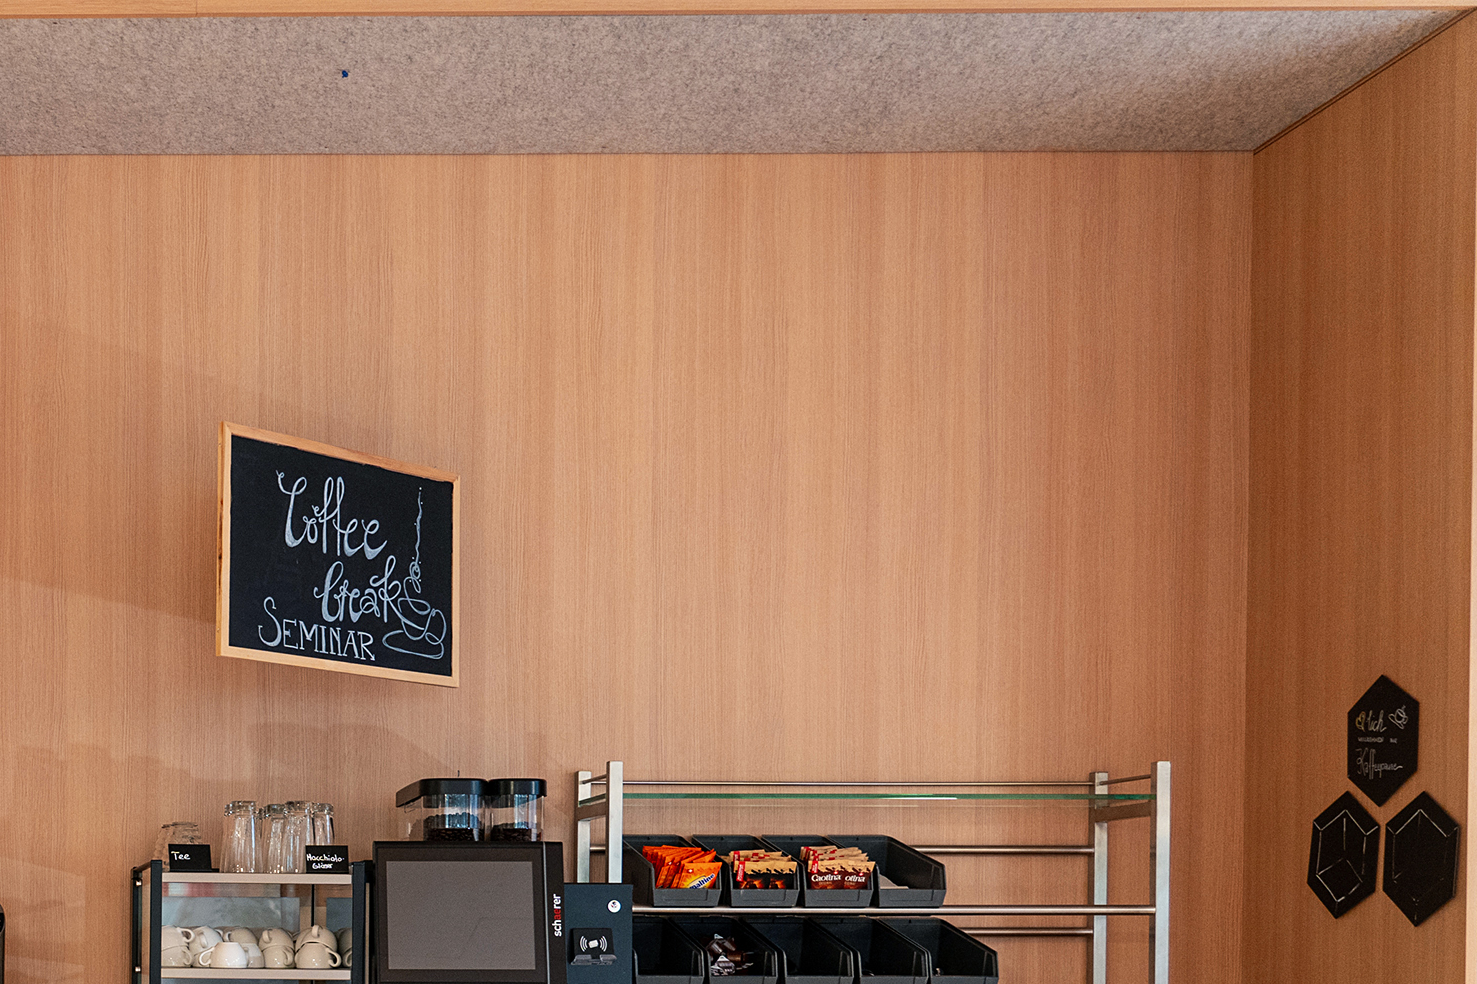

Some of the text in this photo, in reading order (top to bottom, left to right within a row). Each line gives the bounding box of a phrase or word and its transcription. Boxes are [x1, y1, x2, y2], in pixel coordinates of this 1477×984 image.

[276, 469, 388, 560] Coffee
[313, 555, 414, 626] break
[257, 596, 376, 661] SEMINAR
[171, 850, 191, 861] Tee
[810, 873, 842, 882] Caotina
[844, 874, 866, 883] otina
[552, 893, 563, 937] schaerer
